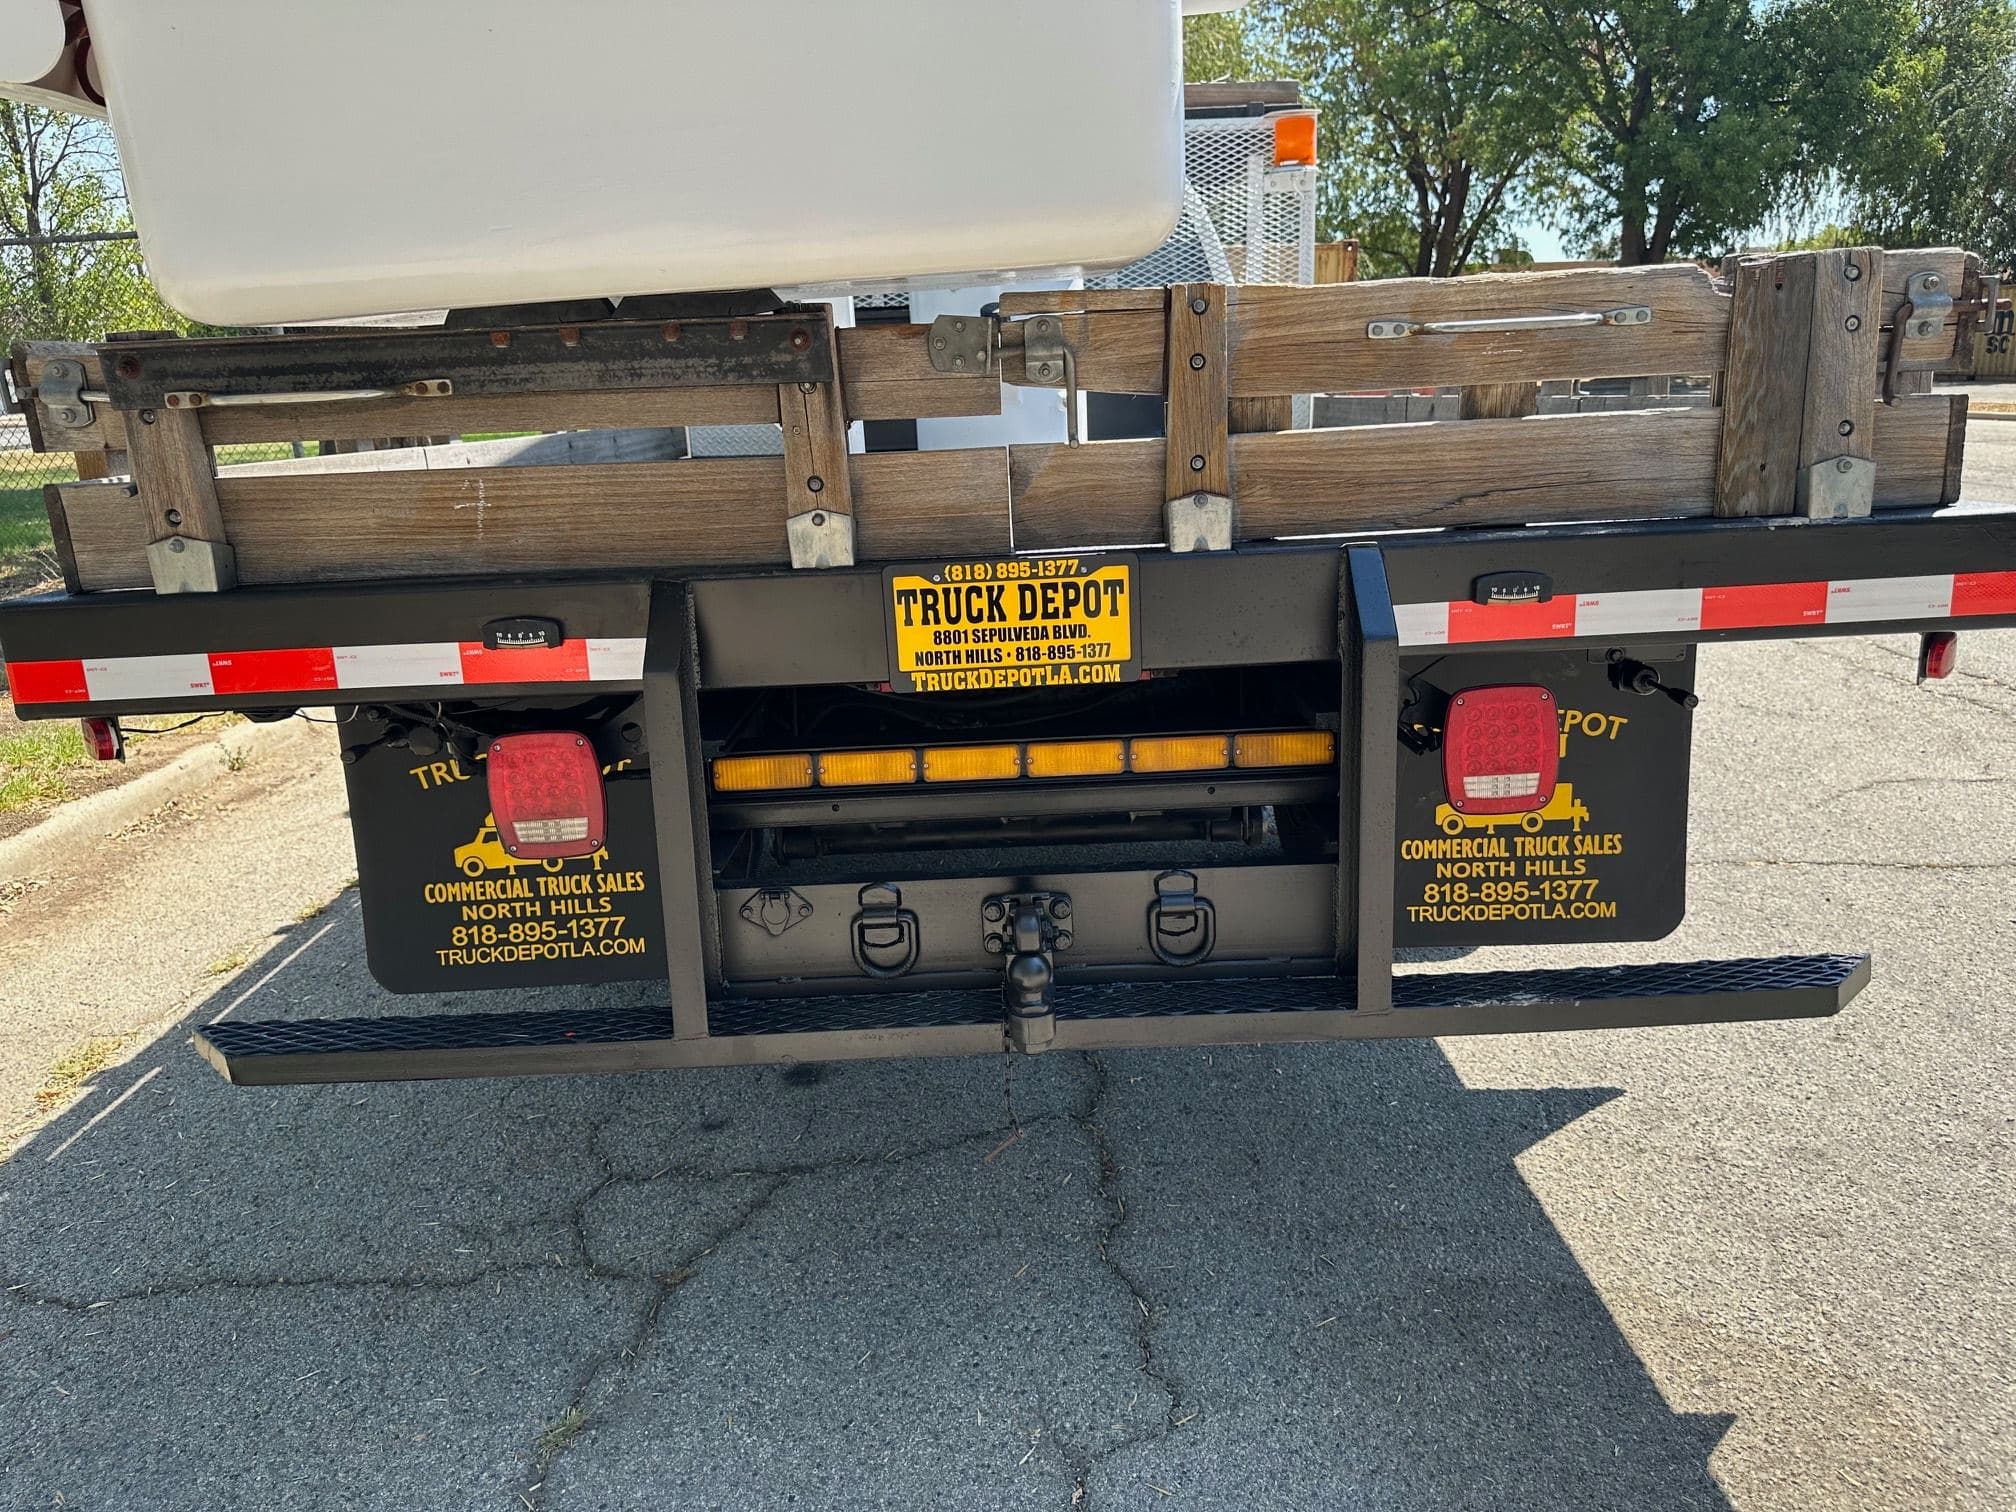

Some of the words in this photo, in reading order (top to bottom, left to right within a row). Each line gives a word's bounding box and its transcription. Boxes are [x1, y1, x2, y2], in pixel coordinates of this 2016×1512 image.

[944, 563, 992, 582] (818)
[996, 559, 1079, 579] 895-1377
[897, 584, 1007, 627] TRUCK
[1018, 578, 1125, 622] DEPOT
[933, 629, 969, 645] 8801
[972, 625, 1049, 644] SEPULVEDA
[1052, 623, 1092, 640] BLVD.
[914, 650, 960, 667] NORTH
[965, 647, 1003, 664] HILLS
[1015, 642, 1112, 662] 818-895-1377
[1400, 836, 1510, 861] COMMERCIAL
[1513, 835, 1572, 857] TRUCK
[1573, 833, 1623, 856] SALES
[1436, 861, 1517, 879] NORTH
[1525, 858, 1587, 876] HILLS
[424, 874, 534, 904] COMMERCIAL
[536, 874, 593, 898] TRUCK
[596, 871, 645, 893] SALES
[1423, 879, 1600, 904] 818-895-1377
[462, 902, 541, 921] NORTH
[551, 897, 612, 917] HILLS
[1406, 901, 1617, 922] TRUCKDEPOTLA.COM
[451, 916, 626, 947] 818-895-1377
[436, 937, 646, 966] TRUCKDEPOTLA.COM
